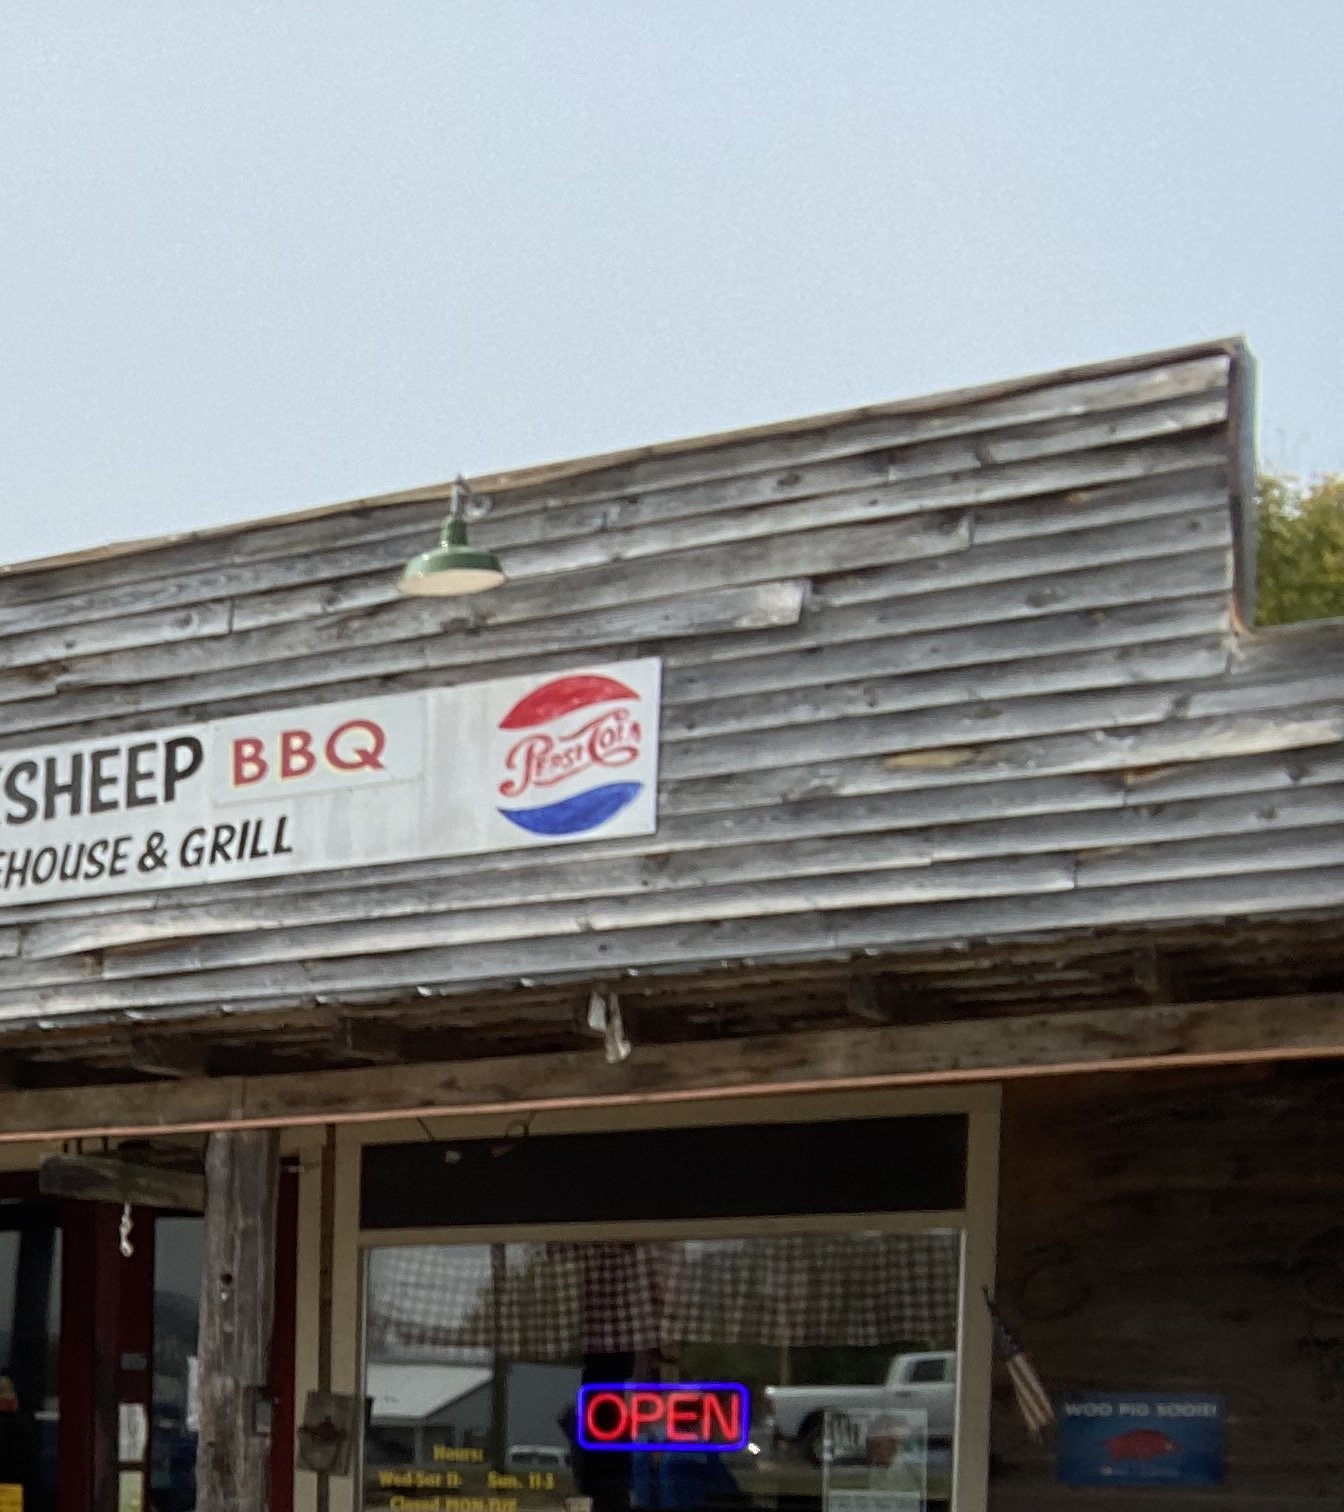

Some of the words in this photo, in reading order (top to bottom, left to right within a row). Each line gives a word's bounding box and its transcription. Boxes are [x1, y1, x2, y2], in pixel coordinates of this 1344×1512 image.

[232, 719, 387, 787] BBQ
[137, 831, 167, 872] &
[179, 816, 293, 867] GRILL
[587, 1391, 740, 1442] OPEN
